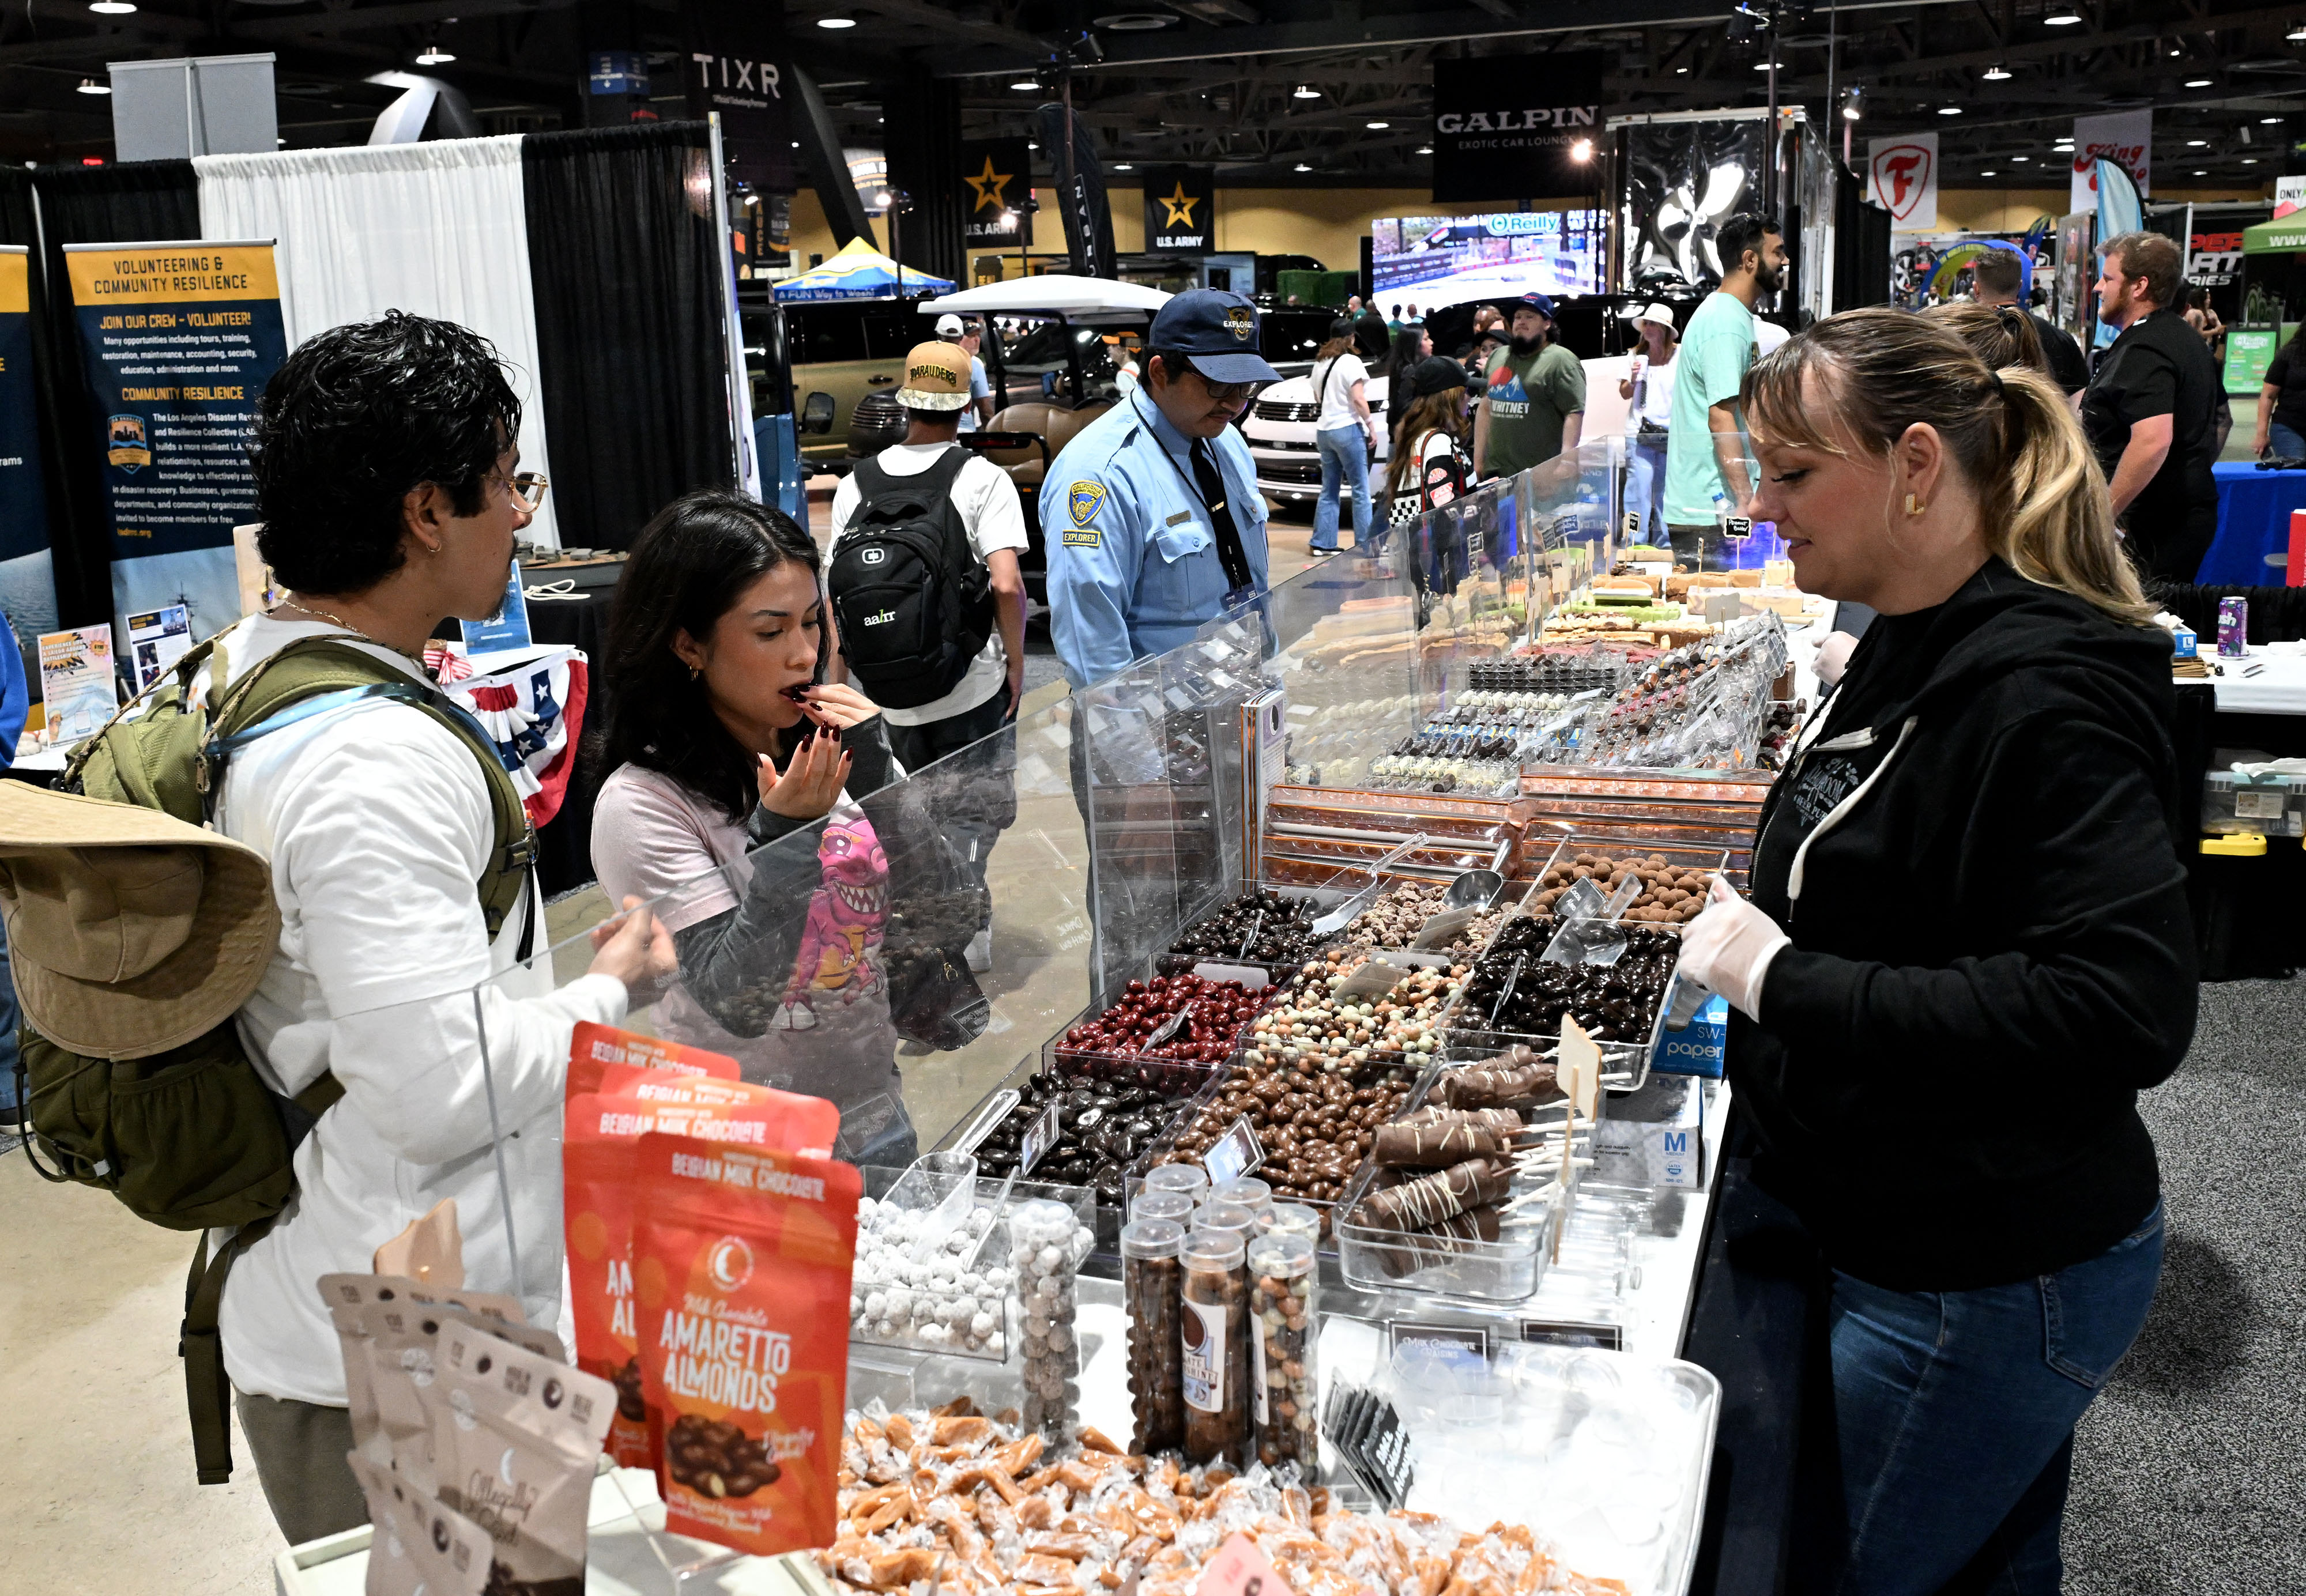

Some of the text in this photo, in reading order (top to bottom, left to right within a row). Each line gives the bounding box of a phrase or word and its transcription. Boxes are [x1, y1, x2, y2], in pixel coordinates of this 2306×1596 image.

[692, 53, 781, 99] TIXR
[1437, 105, 1598, 134] GALPIN
[1459, 139, 1498, 150] EXOTIC
[1502, 138, 1524, 147] CAR
[2280, 189, 2302, 199] ONLY
[1156, 236, 1204, 247] U.S. ARMY
[114, 256, 223, 274] VOLUNTEERING &
[95, 274, 247, 294] COMMUNITY RESILIENCE
[787, 289, 807, 299] FUN
[100, 315, 123, 329] JOIN
[125, 315, 146, 329] OUR
[149, 314, 176, 328] CREW
[187, 312, 252, 327] VOLUNTEER!
[103, 334, 251, 346] Many opportunities including tours, training,
[102, 349, 257, 360] restoration, maintenance, accounting, security,
[120, 366, 155, 375] education,
[156, 364, 204, 373] administration
[205, 364, 219, 372] and
[910, 365, 957, 387] MARAUDERS
[122, 386, 244, 401] COMMUNITY RESILIENCE
[1491, 401, 1529, 414] WHITNEY
[152, 413, 166, 422] The
[167, 413, 179, 422] Los
[180, 414, 208, 423] Angeles
[208, 413, 237, 422] Disaster
[155, 428, 167, 436] and
[168, 428, 202, 436] Resilience
[202, 428, 237, 437] Collective
[156, 443, 176, 451] builds
[202, 443, 229, 451] resilient
[157, 458, 202, 466] relationships,
[159, 471, 196, 482] knowledge
[205, 472, 240, 482] effectively
[120, 485, 145, 494] disaster
[146, 487, 178, 496] recovery.
[179, 486, 220, 495] Businesses,
[1073, 484, 1101, 495] CALIFORNIA
[1087, 489, 1098, 498] PATROL
[114, 500, 157, 510] departments,
[157, 500, 171, 509] and
[172, 501, 210, 511] community
[146, 514, 173, 523] become
[175, 515, 207, 523] members
[208, 515, 218, 523] for
[220, 515, 235, 523] free.
[1064, 533, 1096, 542] EXPLORER
[1667, 1042, 1723, 1058] paper
[591, 1040, 626, 1063] BELGIAN
[628, 1051, 647, 1067] MILK
[649, 1055, 708, 1077] CHOCOLATE
[600, 1112, 654, 1135] BELGIAN
[657, 1116, 689, 1136] MILK
[692, 1118, 767, 1144] CHOCOLATE
[1665, 1132, 1686, 1152] M
[672, 1152, 722, 1181] BELGIAN
[724, 1163, 753, 1187] MILK
[757, 1167, 825, 1202] CHOCOLATE
[683, 1292, 768, 1326] Milk Chocolate
[660, 1308, 791, 1375] AMARETTO
[664, 1352, 778, 1414] ALMONDS
